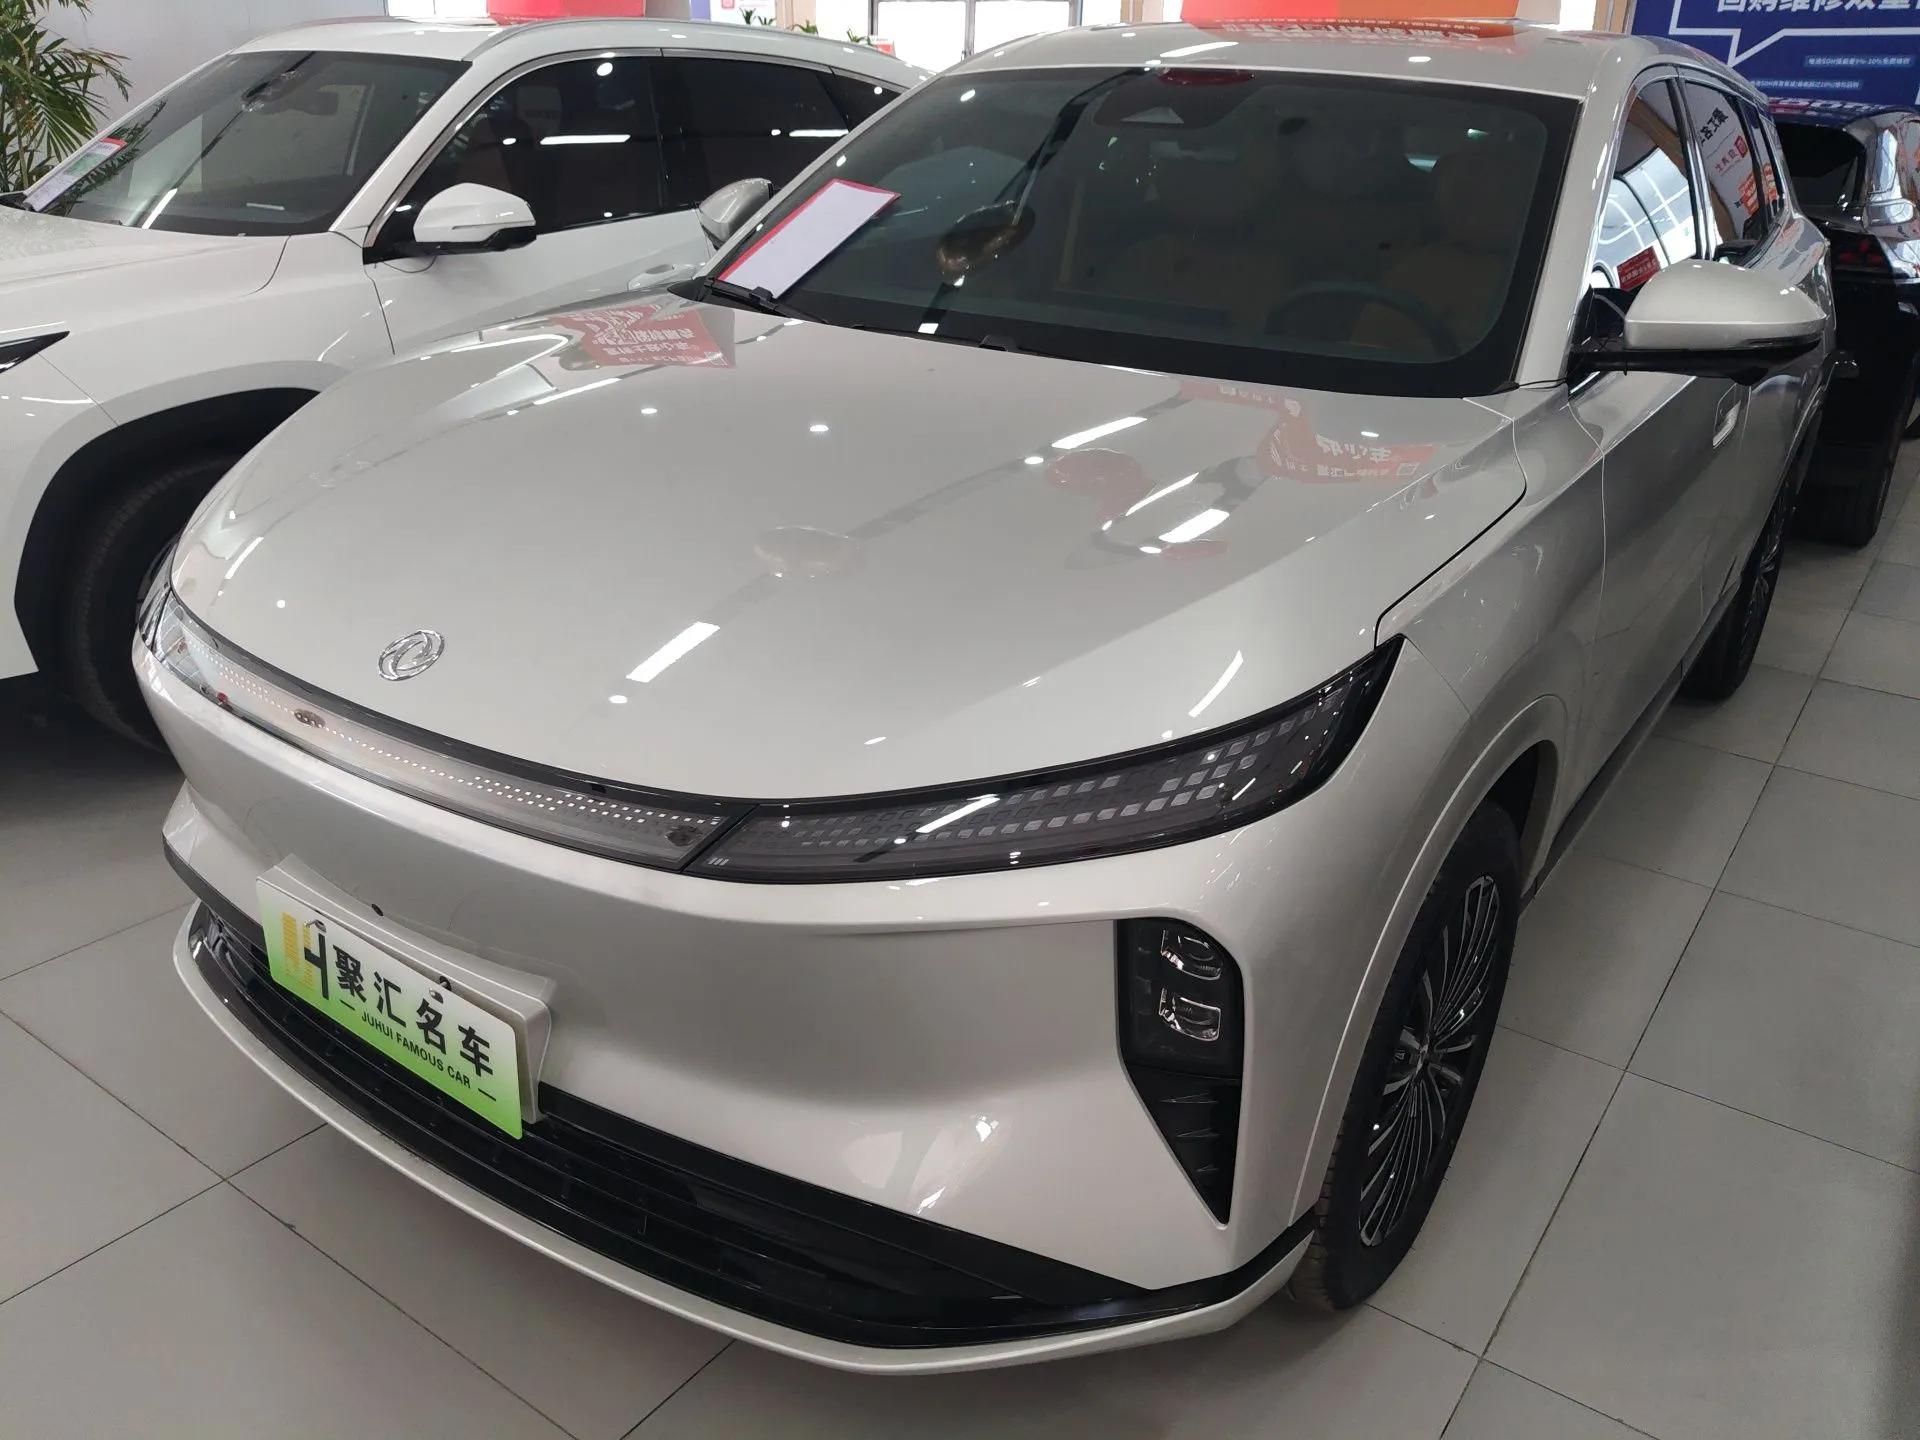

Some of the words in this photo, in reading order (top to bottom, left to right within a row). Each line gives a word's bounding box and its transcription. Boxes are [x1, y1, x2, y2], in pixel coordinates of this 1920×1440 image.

[332, 944, 494, 1077] 聚汇名车
[361, 1011, 394, 1040] JUHUI
[396, 1032, 445, 1073] FAMOUS
[447, 1065, 472, 1089] CAR
